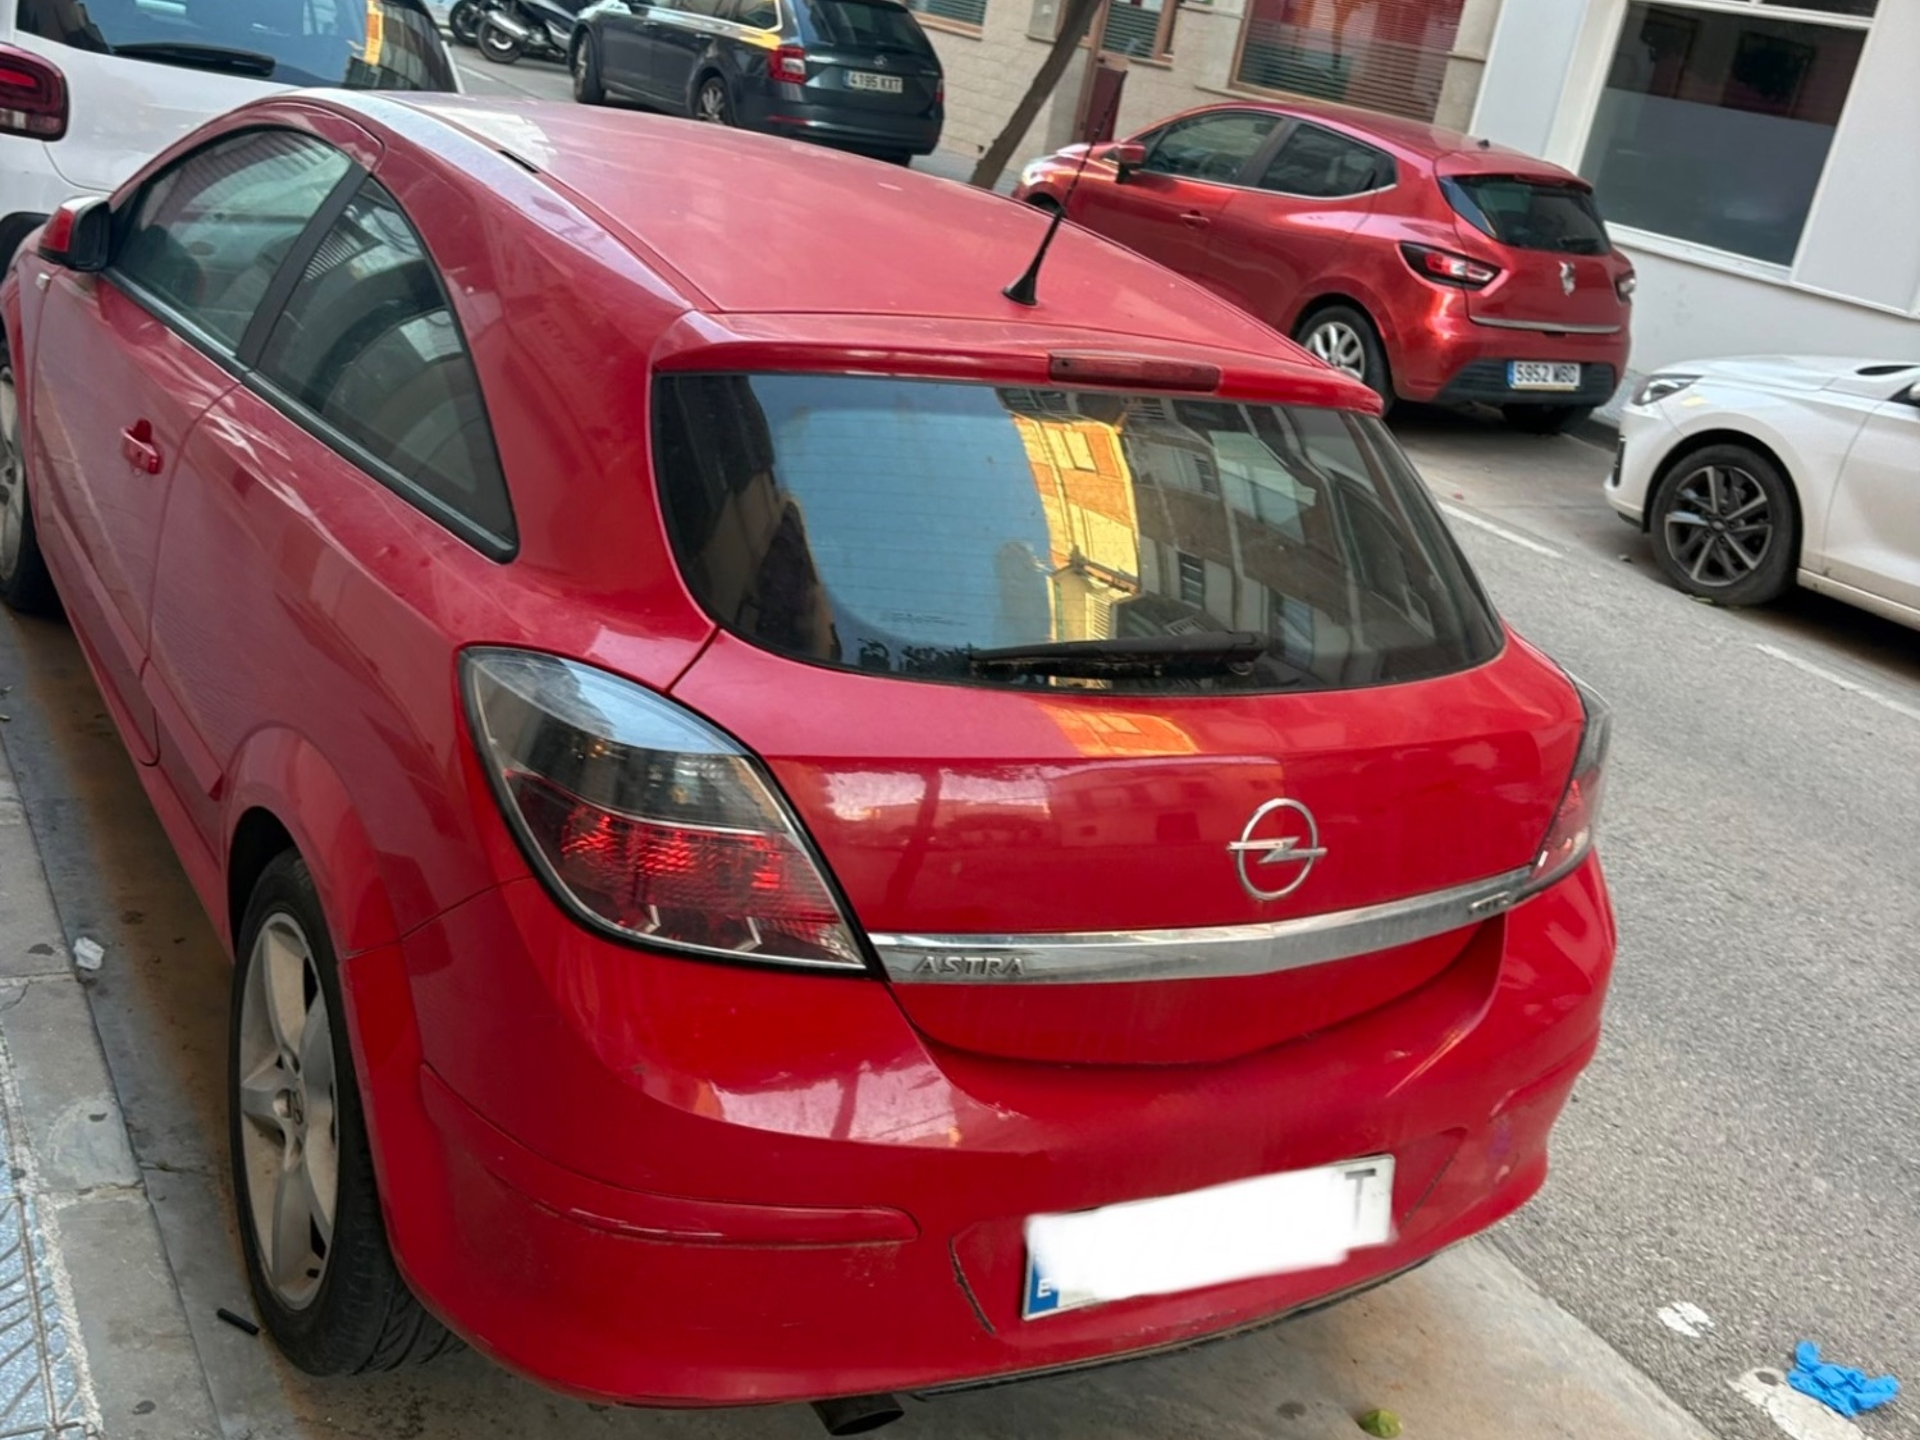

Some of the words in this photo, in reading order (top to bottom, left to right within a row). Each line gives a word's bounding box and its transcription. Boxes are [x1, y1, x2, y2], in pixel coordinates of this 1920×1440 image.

[851, 73, 878, 88] 4195
[1516, 363, 1550, 383] 5952
[915, 956, 1025, 976] ASTRA
